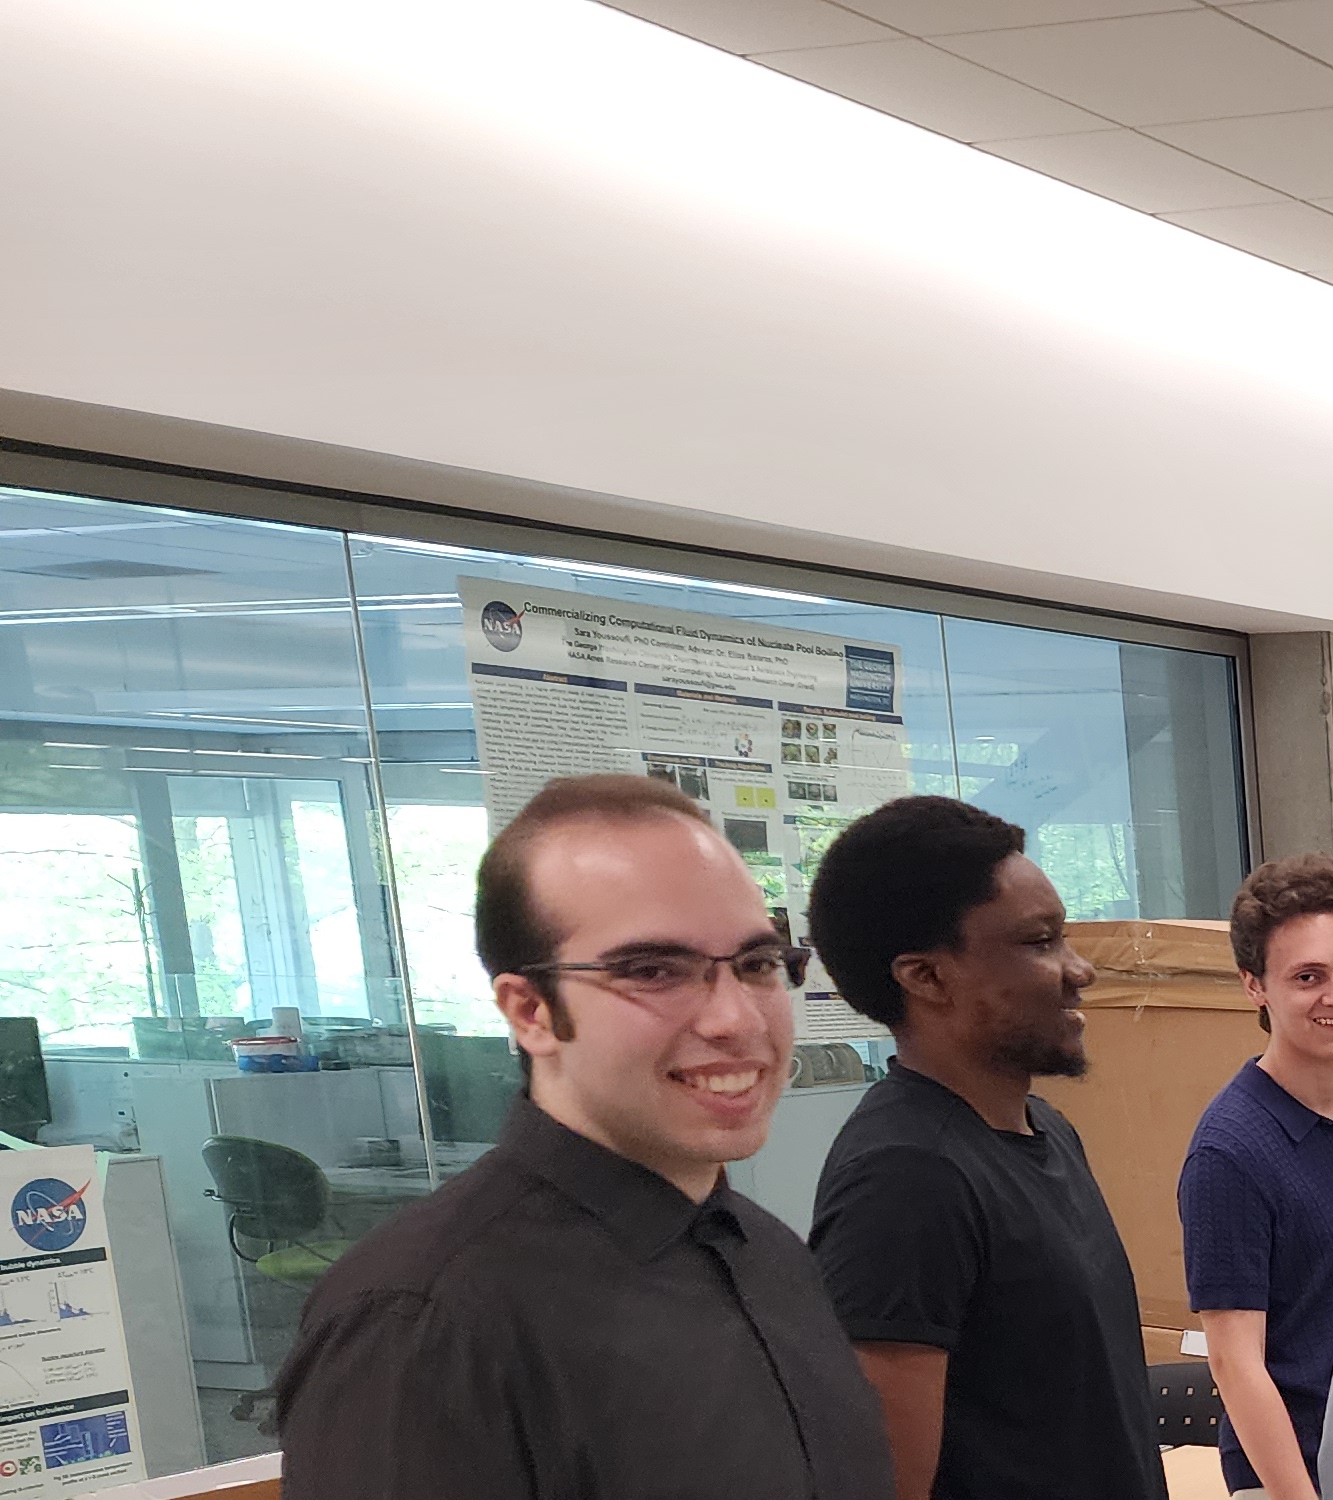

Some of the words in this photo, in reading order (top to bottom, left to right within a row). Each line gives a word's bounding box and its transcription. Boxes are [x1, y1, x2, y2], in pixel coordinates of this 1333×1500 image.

[484, 618, 521, 635] NASA
[524, 601, 606, 626] Commercializing
[796, 643, 814, 654] Pool
[16, 1204, 84, 1226] NASA
